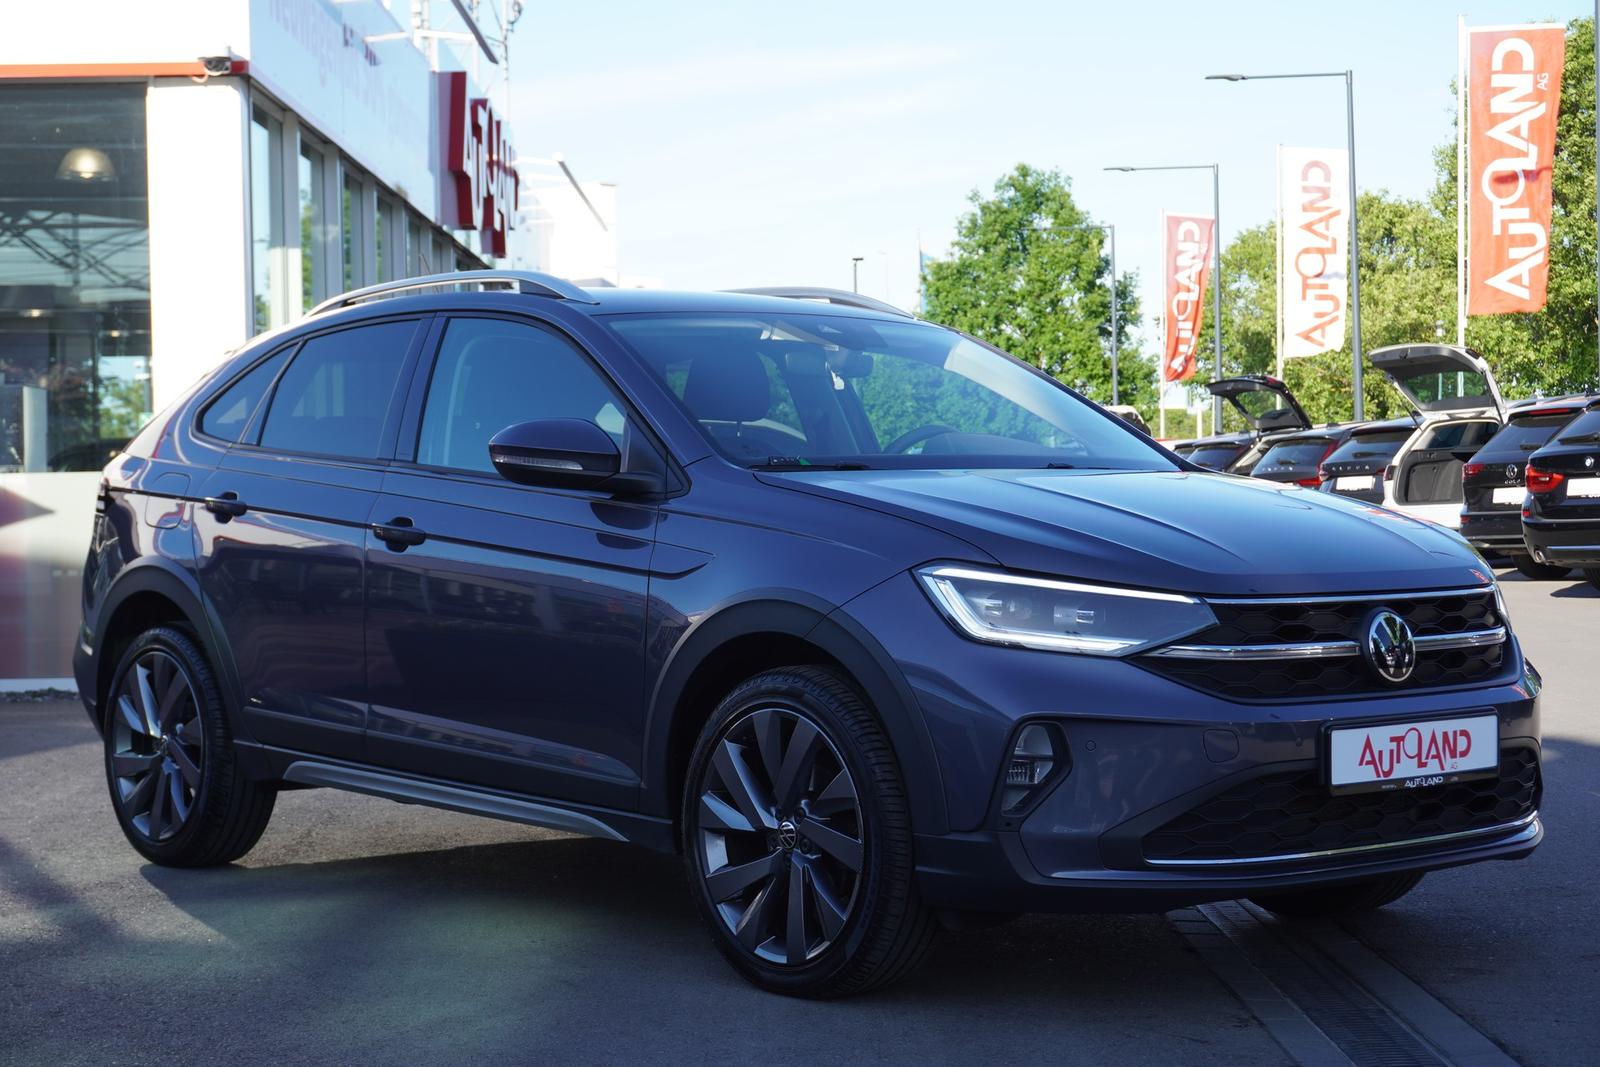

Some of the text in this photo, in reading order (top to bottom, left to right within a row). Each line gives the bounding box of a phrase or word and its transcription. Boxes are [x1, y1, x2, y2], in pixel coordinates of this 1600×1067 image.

[1537, 72, 1549, 91] AG
[1481, 37, 1548, 300] AUTOLAND
[1295, 160, 1342, 347] AUTOLAND
[1358, 727, 1472, 778] AUTOLAND
[1404, 776, 1444, 788] AUTOLAND
